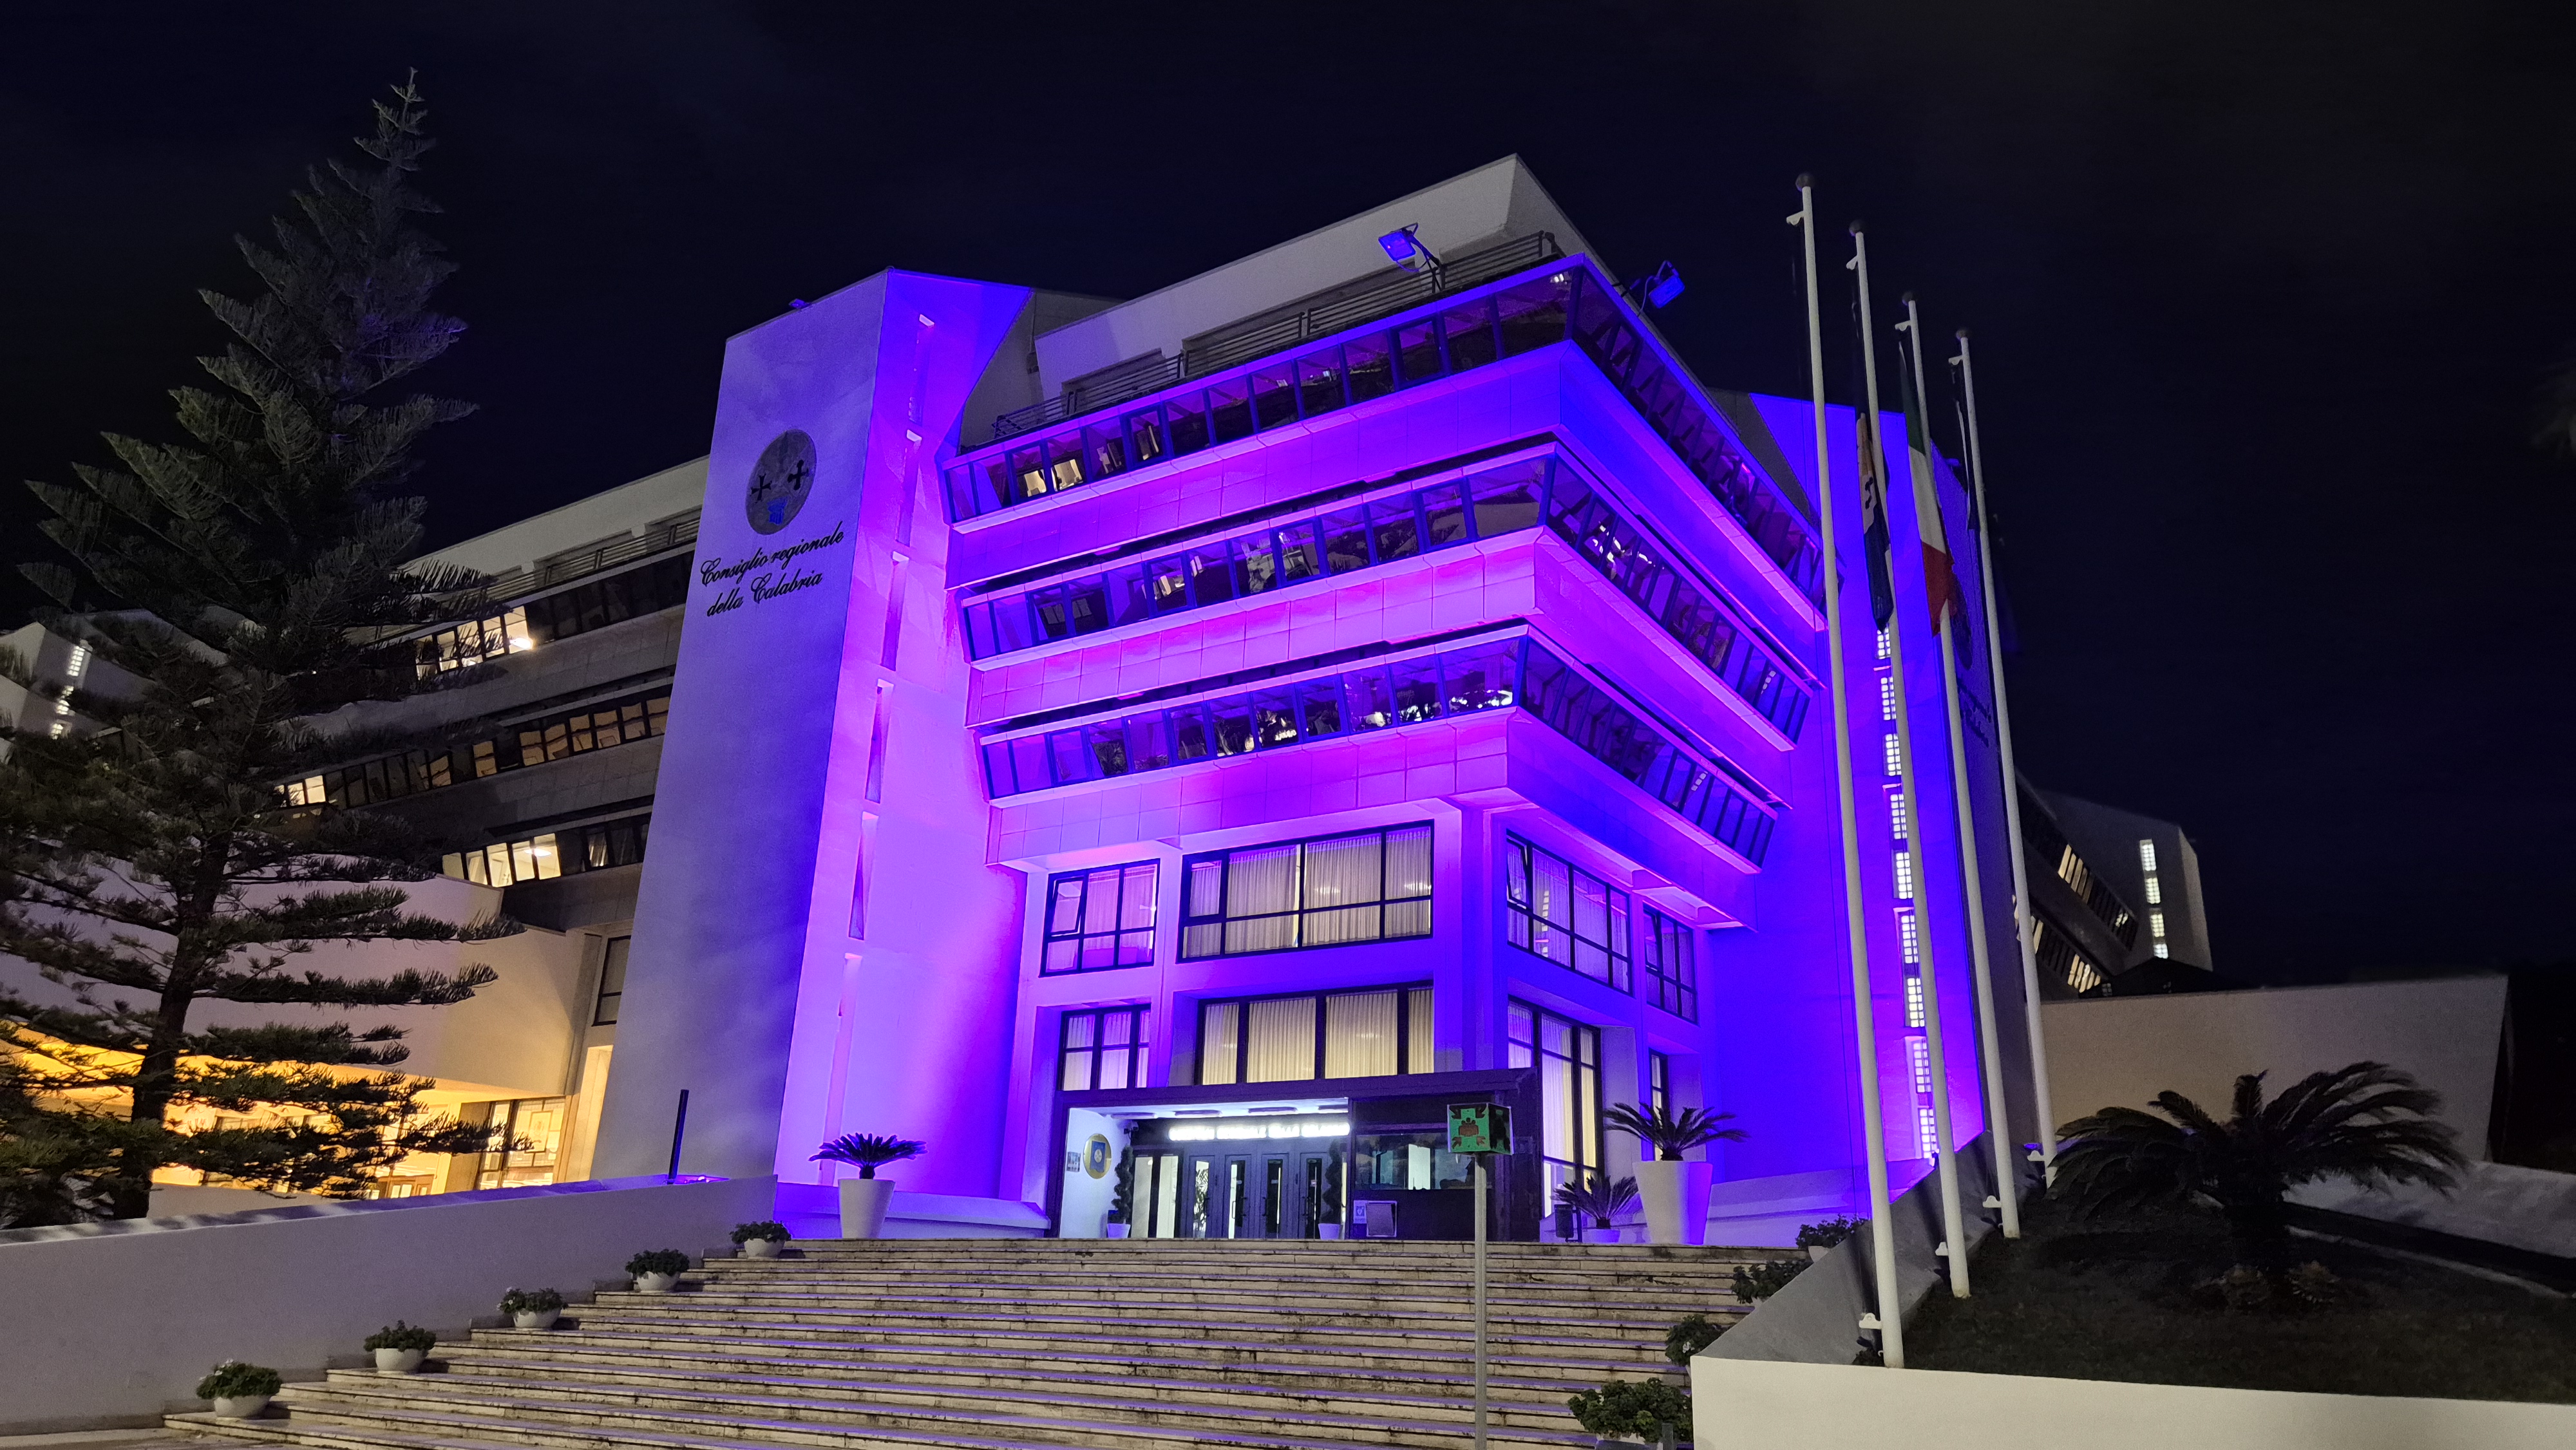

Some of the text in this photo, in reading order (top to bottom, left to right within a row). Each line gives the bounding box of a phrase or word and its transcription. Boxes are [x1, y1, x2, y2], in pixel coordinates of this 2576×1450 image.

[701, 520, 845, 587] Consiglio regionale
[706, 568, 824, 617] della Calabria
